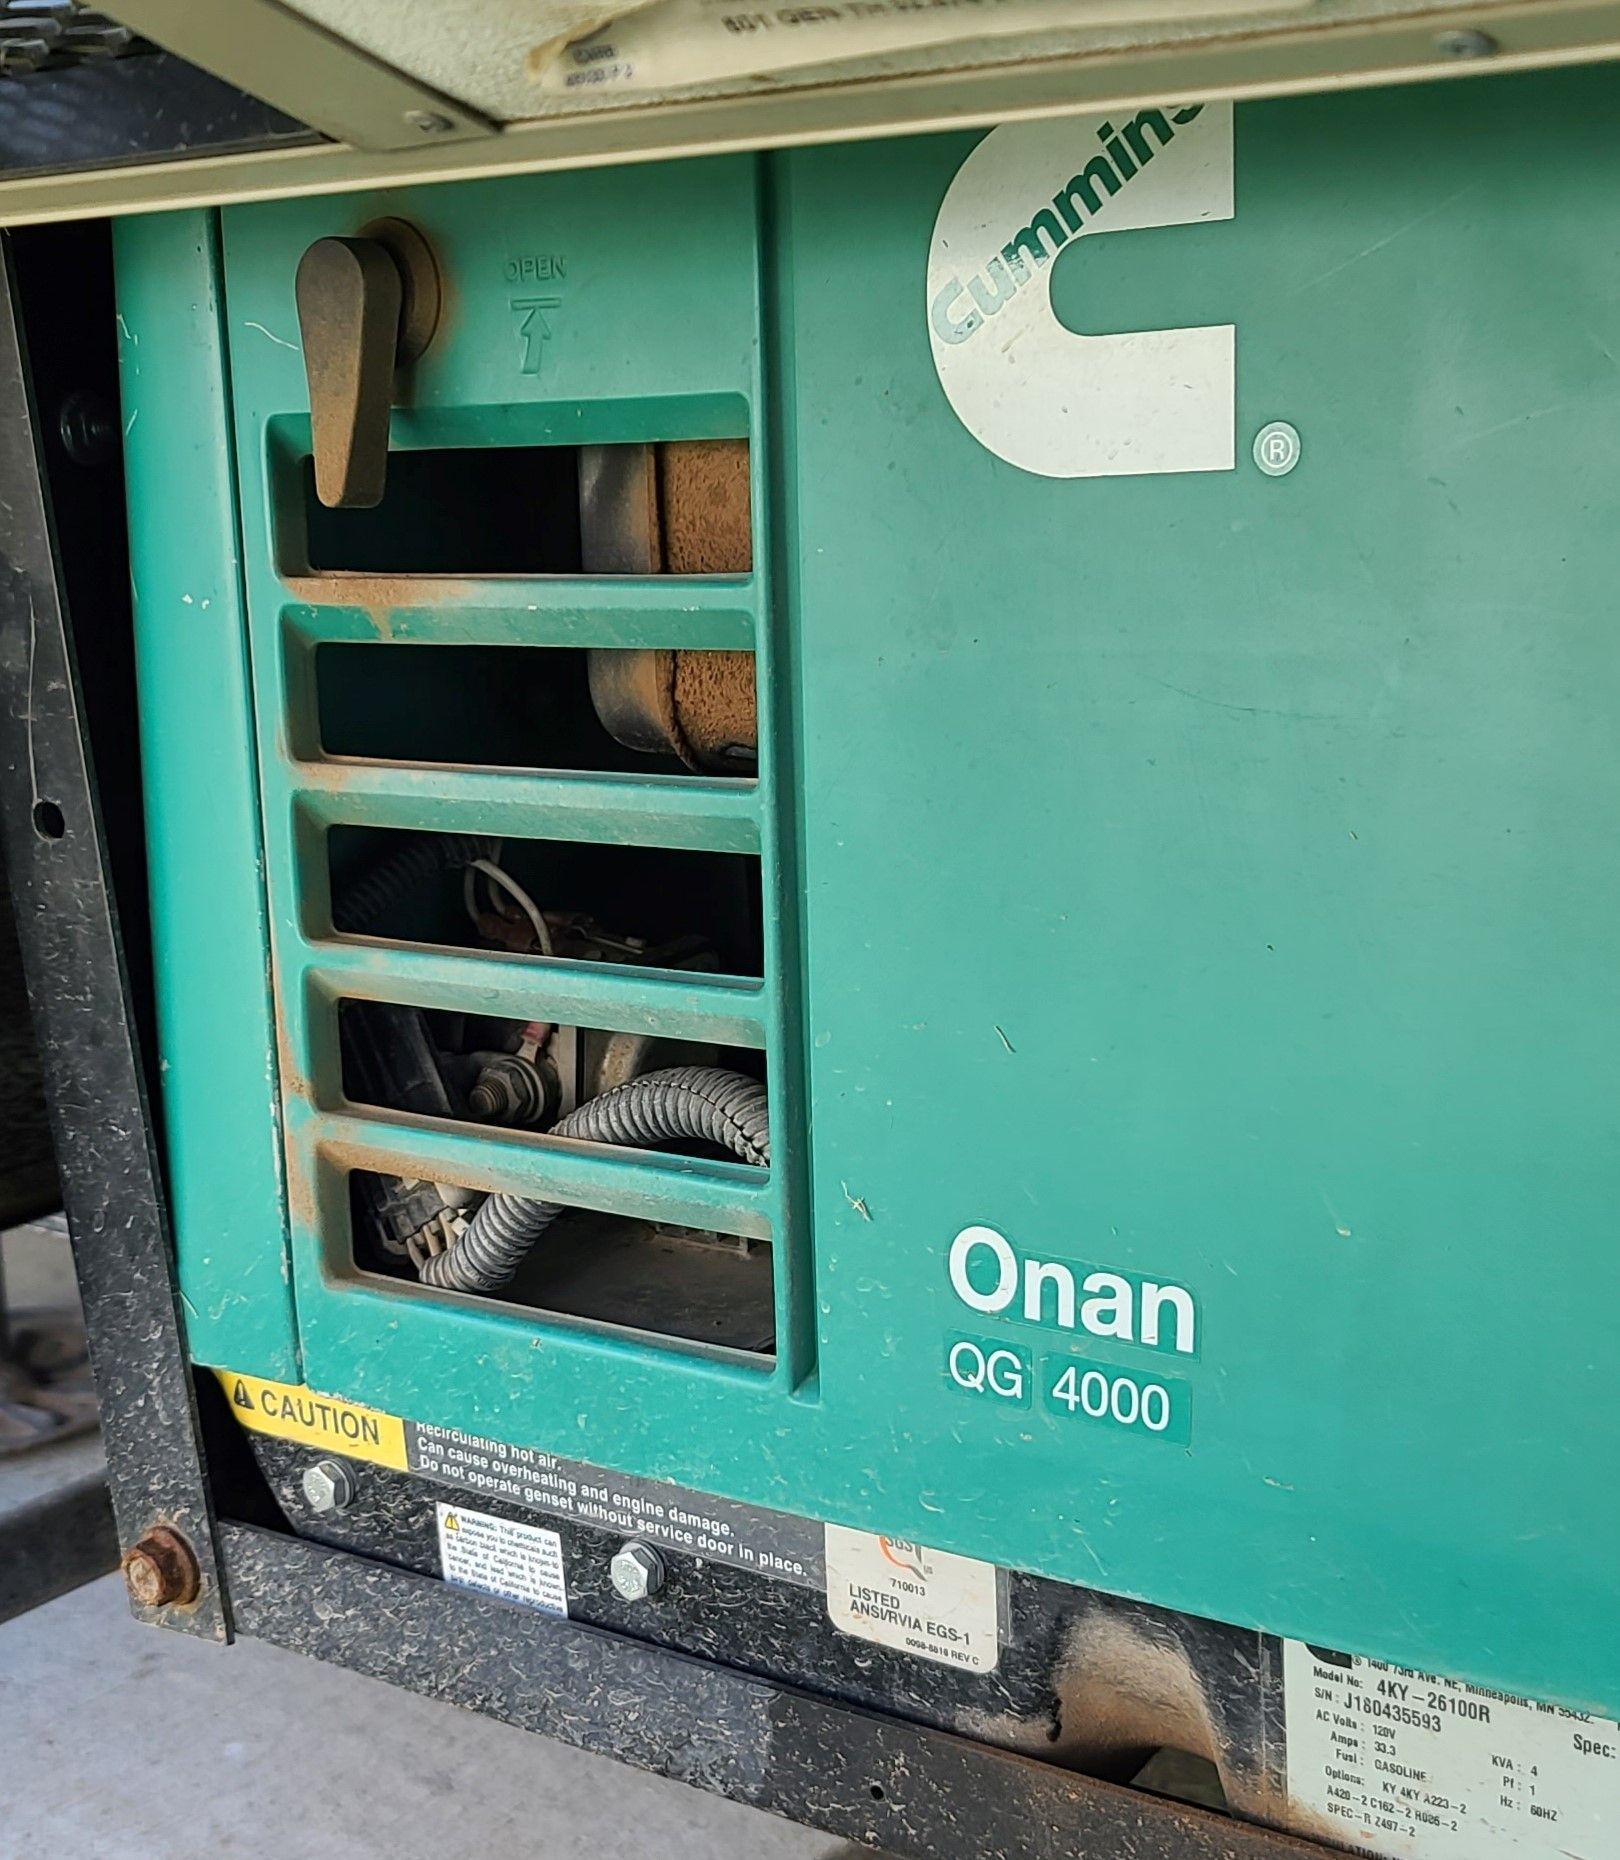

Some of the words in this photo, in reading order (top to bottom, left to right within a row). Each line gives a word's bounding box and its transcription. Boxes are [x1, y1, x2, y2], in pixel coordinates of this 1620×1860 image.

[504, 256, 567, 282] OPEN
[948, 1225, 1195, 1354] Onan
[949, 1341, 1023, 1399] QG
[1052, 1366, 1171, 1431] 4000
[261, 1388, 380, 1445] CAUTION
[511, 1445, 535, 1463] hot
[538, 1453, 562, 1471] air.
[417, 1436, 444, 1456] Can
[448, 1448, 489, 1468] cause
[492, 1460, 576, 1498] overheating
[580, 1482, 608, 1502] and
[612, 1492, 665, 1519] engine
[668, 1507, 735, 1537] damage.
[419, 1455, 439, 1471] Do
[442, 1462, 465, 1480] not
[468, 1471, 521, 1496] operate
[524, 1487, 574, 1512] genset
[577, 1501, 634, 1528] without
[637, 1517, 693, 1545] service
[697, 1534, 734, 1555] door
[738, 1542, 754, 1560] in
[758, 1551, 807, 1577] place.
[849, 1583, 900, 1610] LISTED
[890, 1578, 926, 1596] 710013
[850, 1600, 923, 1632] ANSI/RVIA
[926, 1621, 970, 1646] EGS-1
[951, 1650, 970, 1662] REV
[972, 1656, 979, 1665] C
[1313, 1666, 1343, 1684] Model
[1344, 1693, 1441, 1732] J180435593
[1536, 1701, 1555, 1715] MN
[1316, 1709, 1330, 1722] AC
[1372, 1724, 1396, 1739] 120V
[1374, 1741, 1396, 1756] 33.3
[1573, 1733, 1616, 1760] Spec:
[1325, 1765, 1365, 1786] Options:
[1382, 1781, 1397, 1794] KY
[1400, 1786, 1420, 1801] 4KY
[1375, 1759, 1427, 1783] GASOLINE
[1530, 1765, 1538, 1777] 4
[1530, 1804, 1558, 1822] 60HZ
